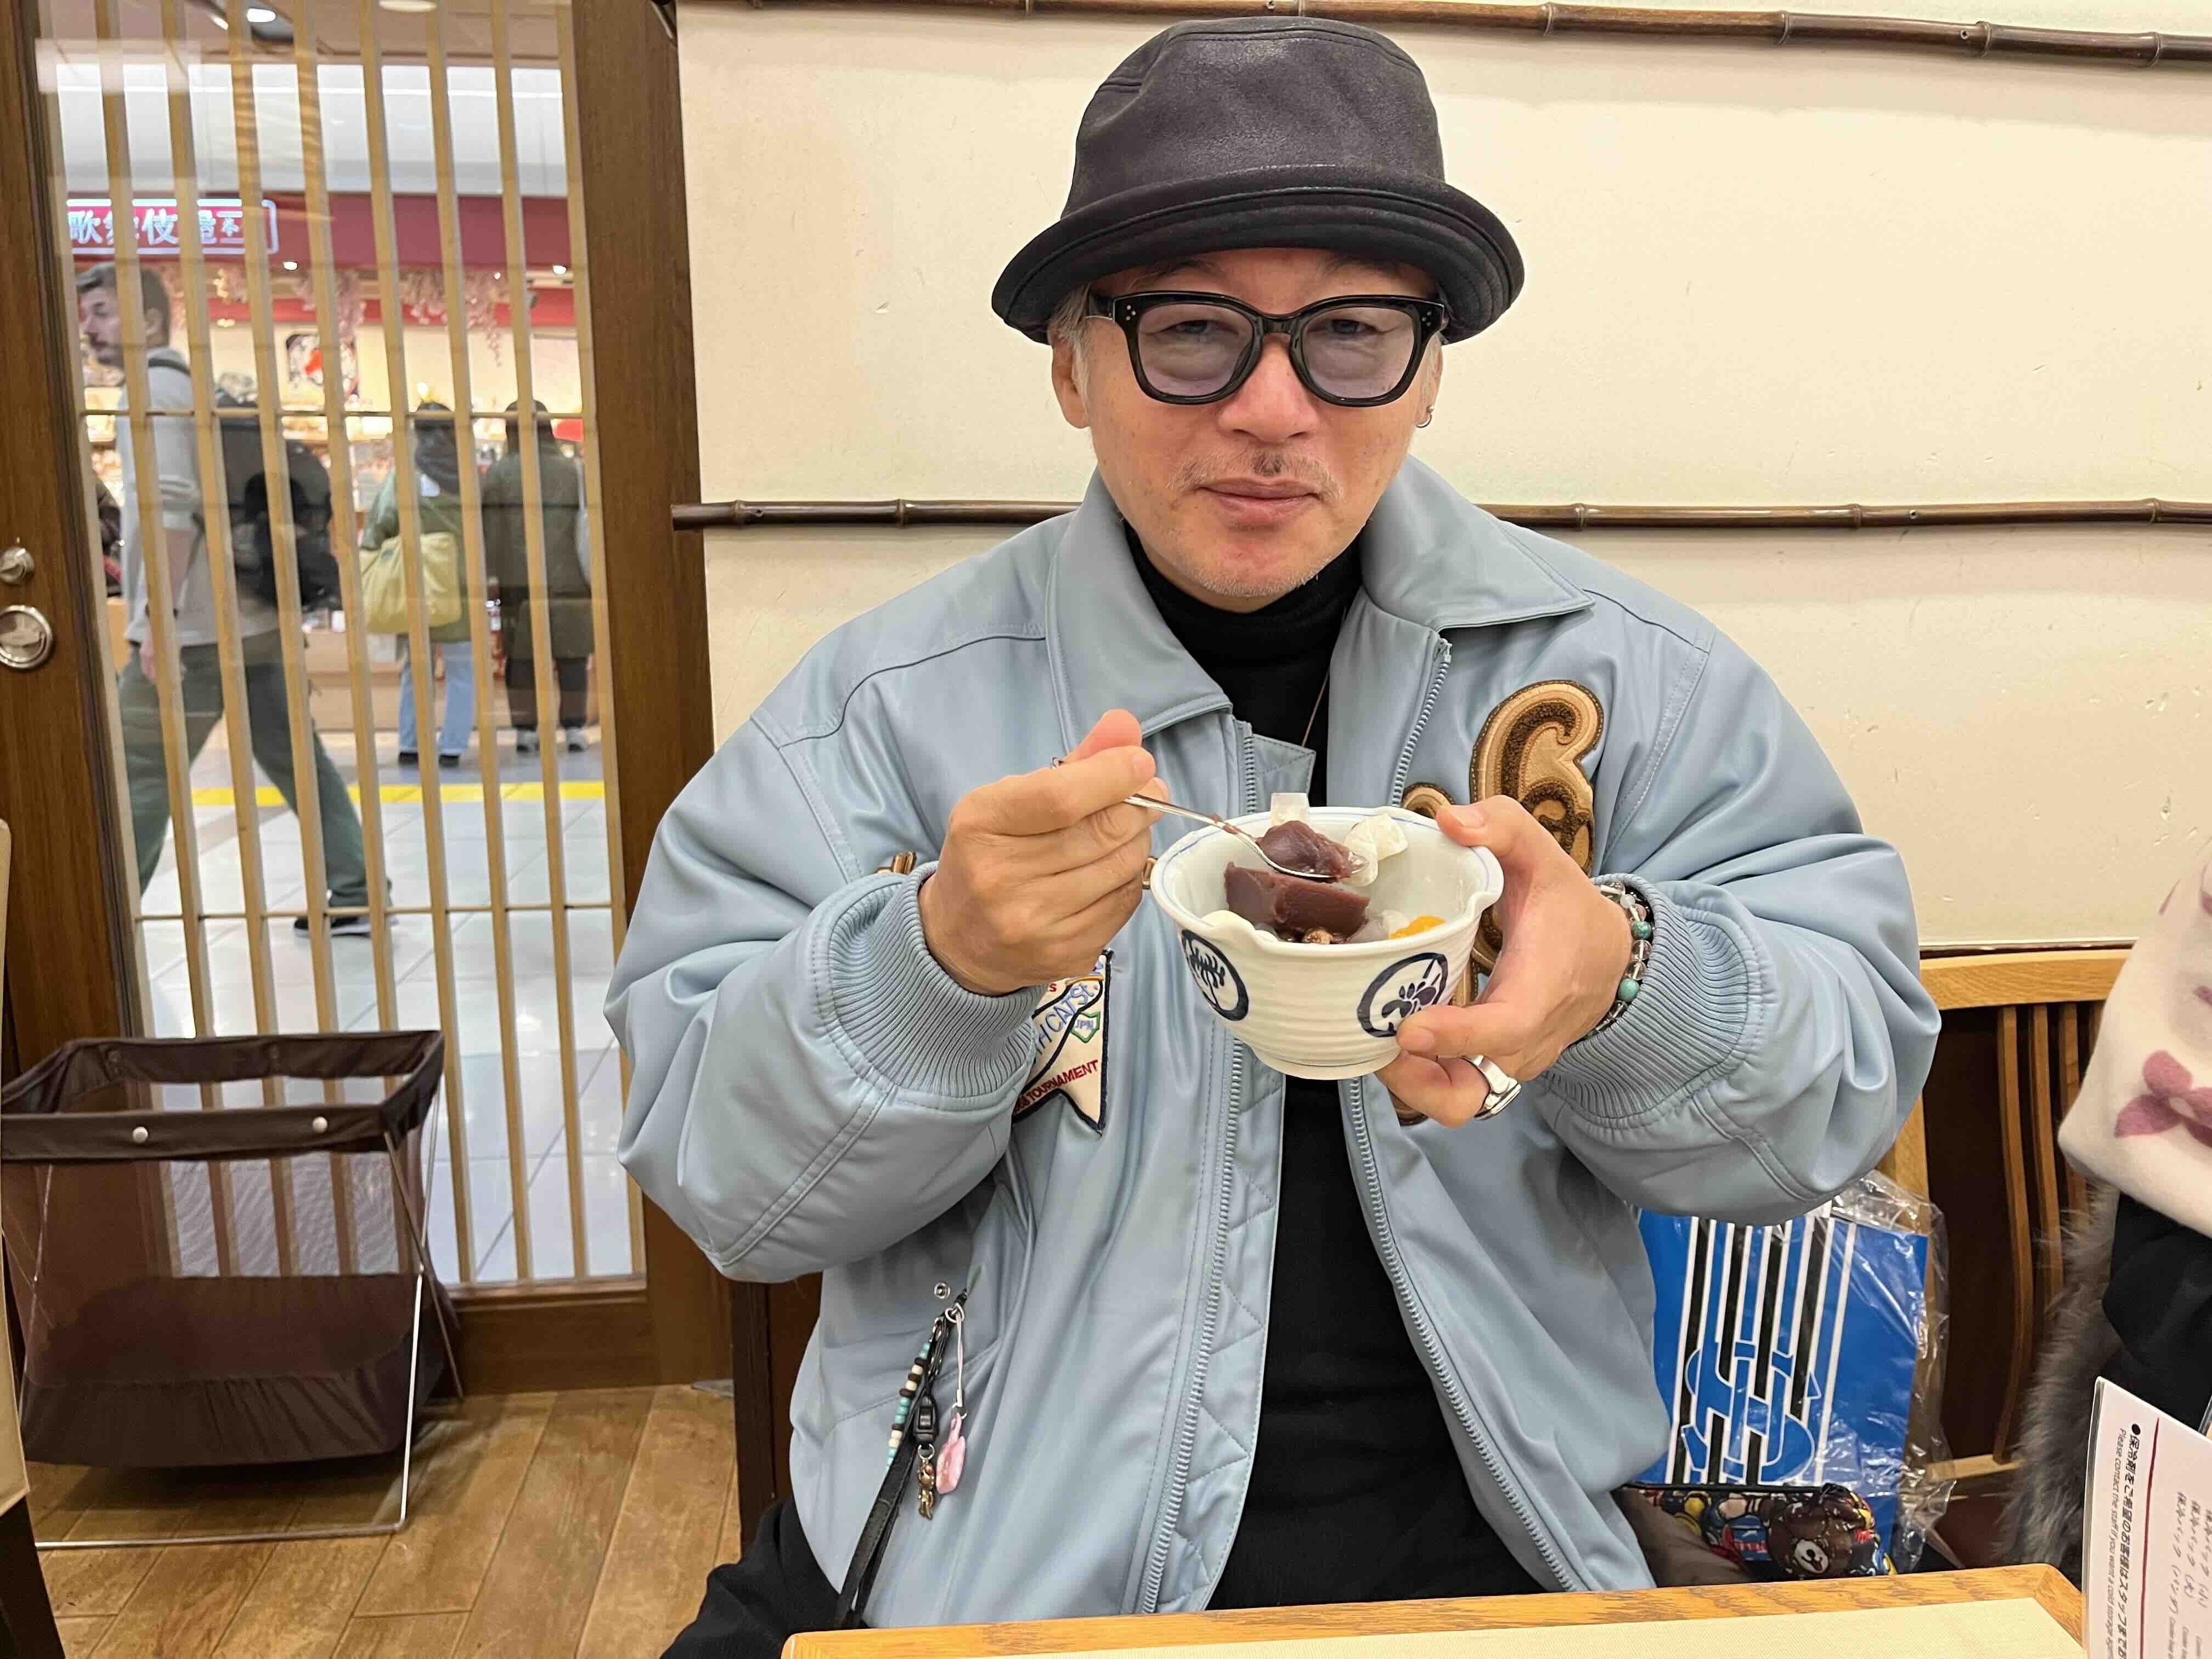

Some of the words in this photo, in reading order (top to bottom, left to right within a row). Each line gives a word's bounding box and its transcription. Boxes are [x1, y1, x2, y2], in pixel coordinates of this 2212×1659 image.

[1028, 1059, 1098, 1101] TOURNAMENT
[2115, 1427, 2126, 1457] Please
[2113, 1458, 2121, 1492] contact
